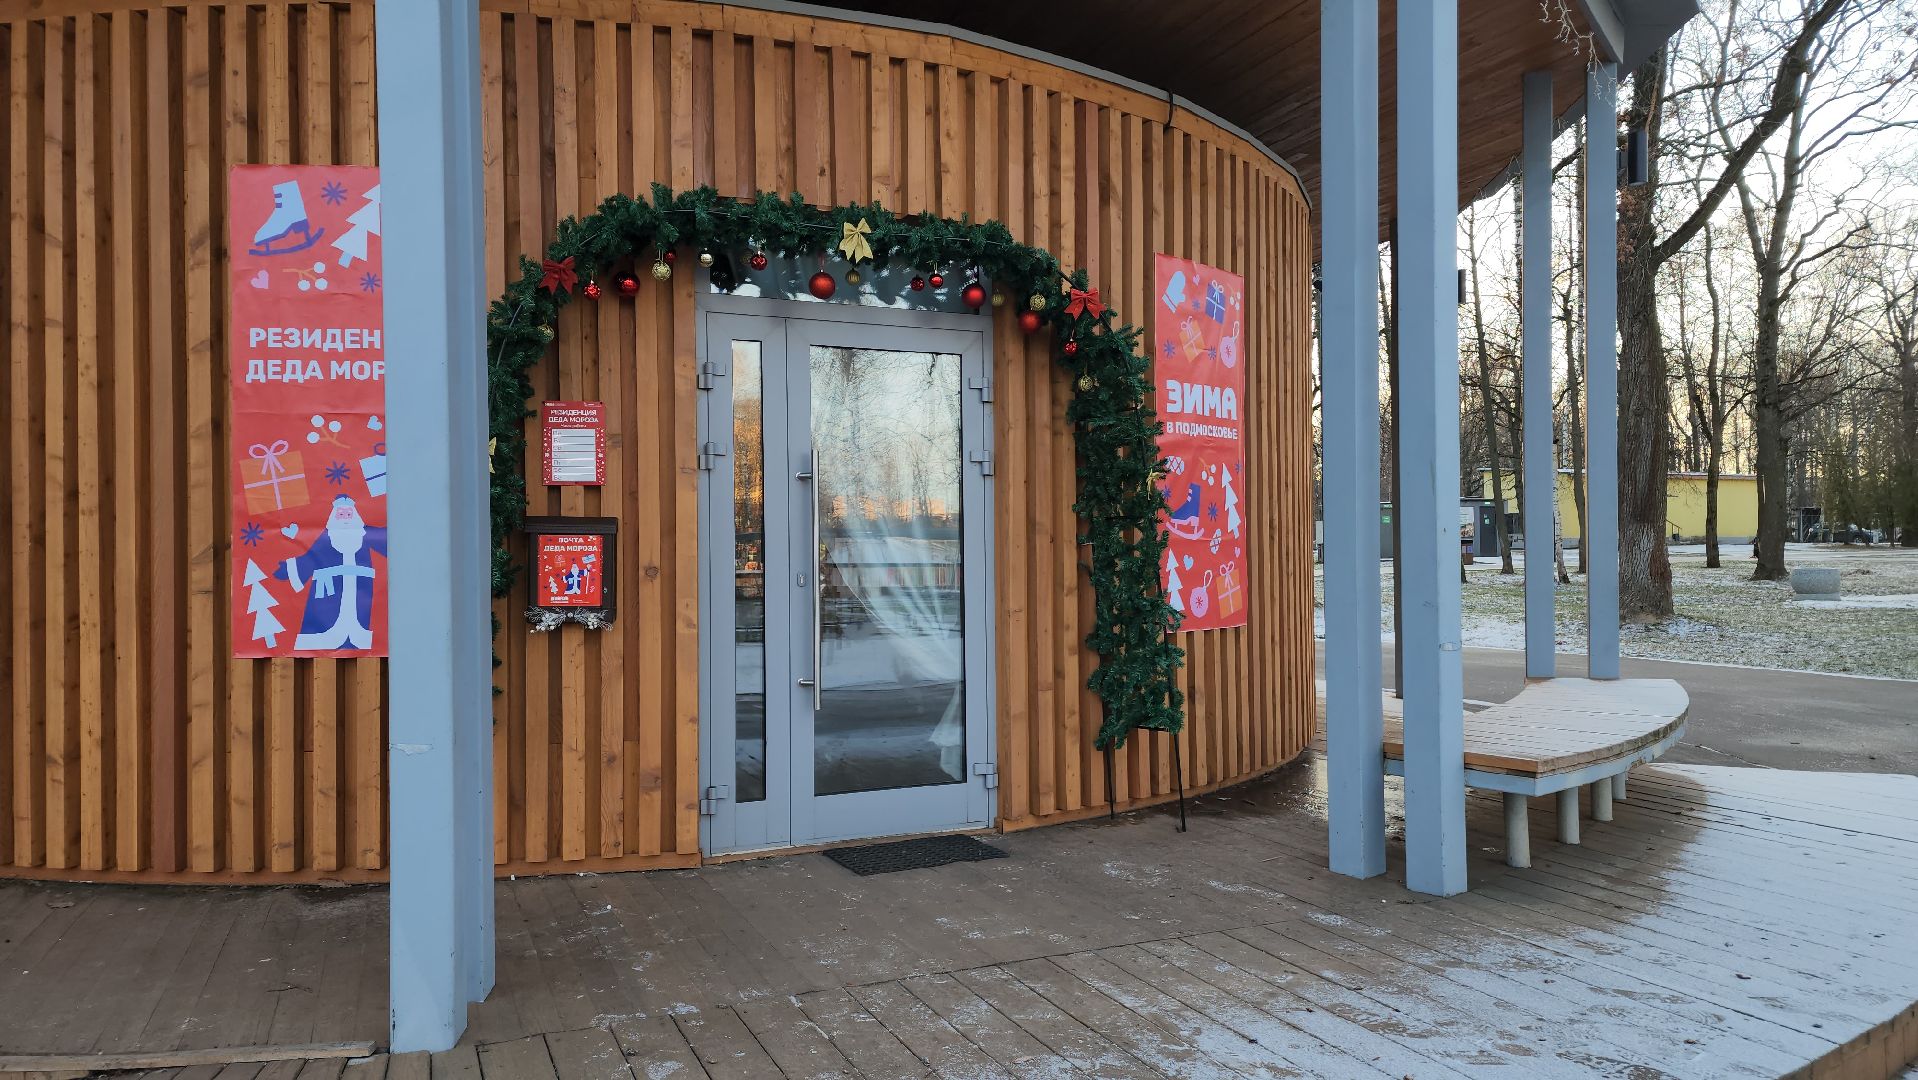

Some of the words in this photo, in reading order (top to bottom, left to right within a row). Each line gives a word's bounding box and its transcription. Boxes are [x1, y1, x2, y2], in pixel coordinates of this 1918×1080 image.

[250, 327, 381, 352] РЕЗИДЕН
[246, 359, 324, 383] ДЕДА
[330, 360, 386, 381] МОР
[1166, 380, 1238, 420] ЗИМА
[1175, 421, 1238, 439] ПОДМОСКОВЬЕ
